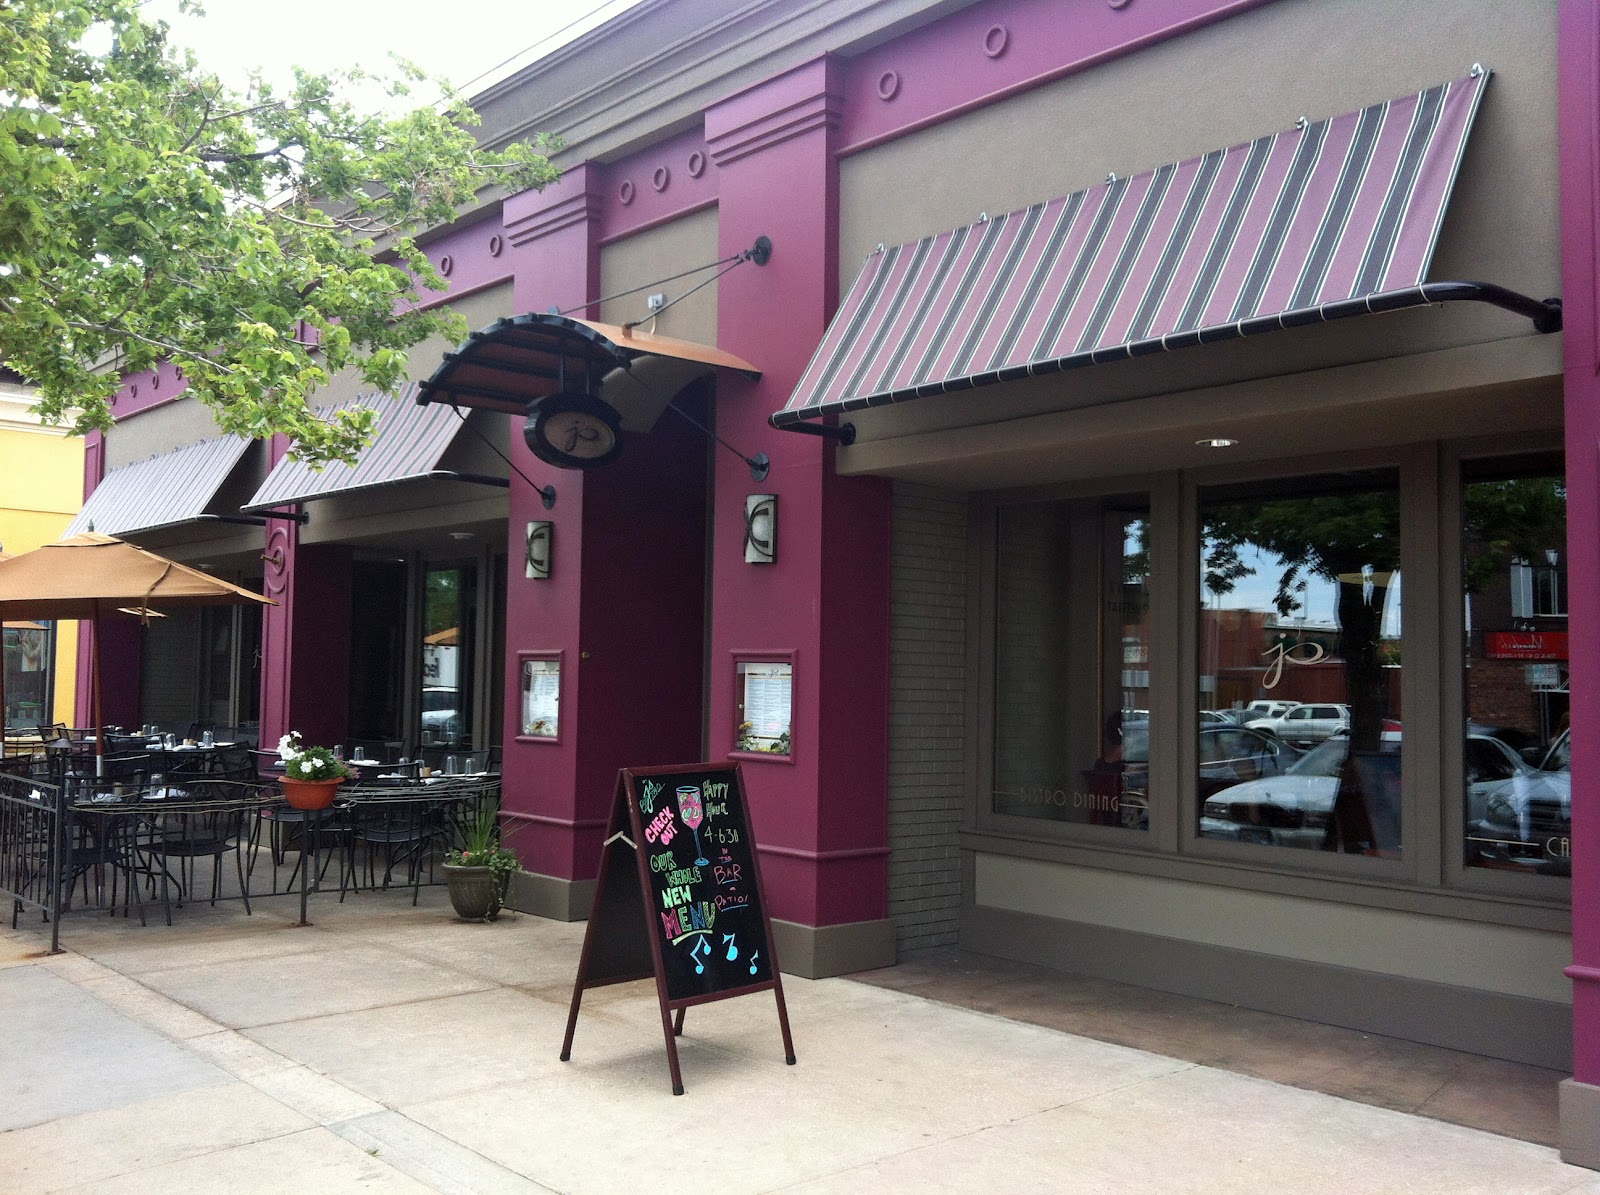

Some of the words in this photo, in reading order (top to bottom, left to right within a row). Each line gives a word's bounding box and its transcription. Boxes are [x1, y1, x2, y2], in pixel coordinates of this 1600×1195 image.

[702, 779, 729, 800] HAPPY
[1074, 791, 1119, 812] DINING
[645, 806, 675, 843] CHECK
[660, 820, 678, 845] OUT
[650, 851, 677, 872] OUR
[665, 866, 702, 888] WHOLE
[714, 864, 742, 885] BAR
[662, 884, 692, 908] NEW
[661, 901, 716, 940] MENU
